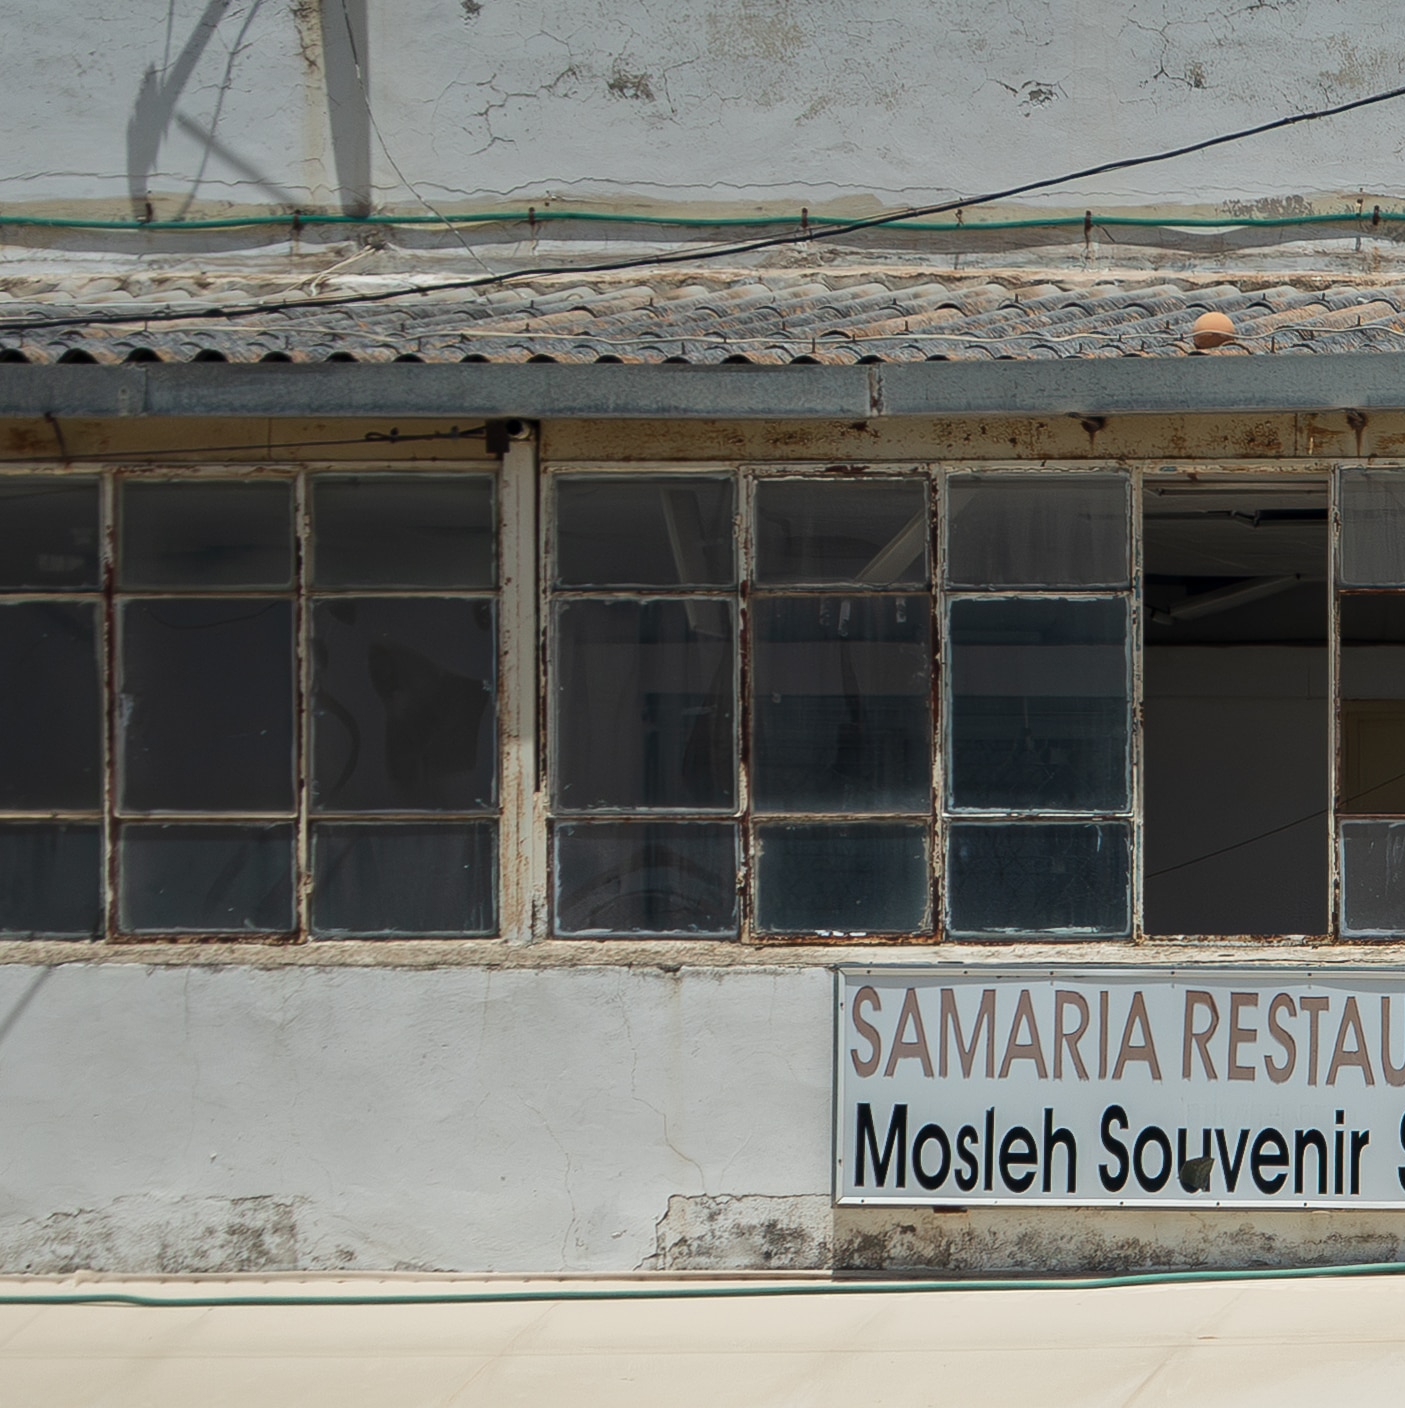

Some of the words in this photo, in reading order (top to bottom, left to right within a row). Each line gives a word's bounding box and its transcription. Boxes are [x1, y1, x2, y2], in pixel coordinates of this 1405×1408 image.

[850, 985, 1163, 1081] SAMARIA
[854, 1102, 1078, 1194] Mosleh
[1098, 1104, 1370, 1195] Souvenir
